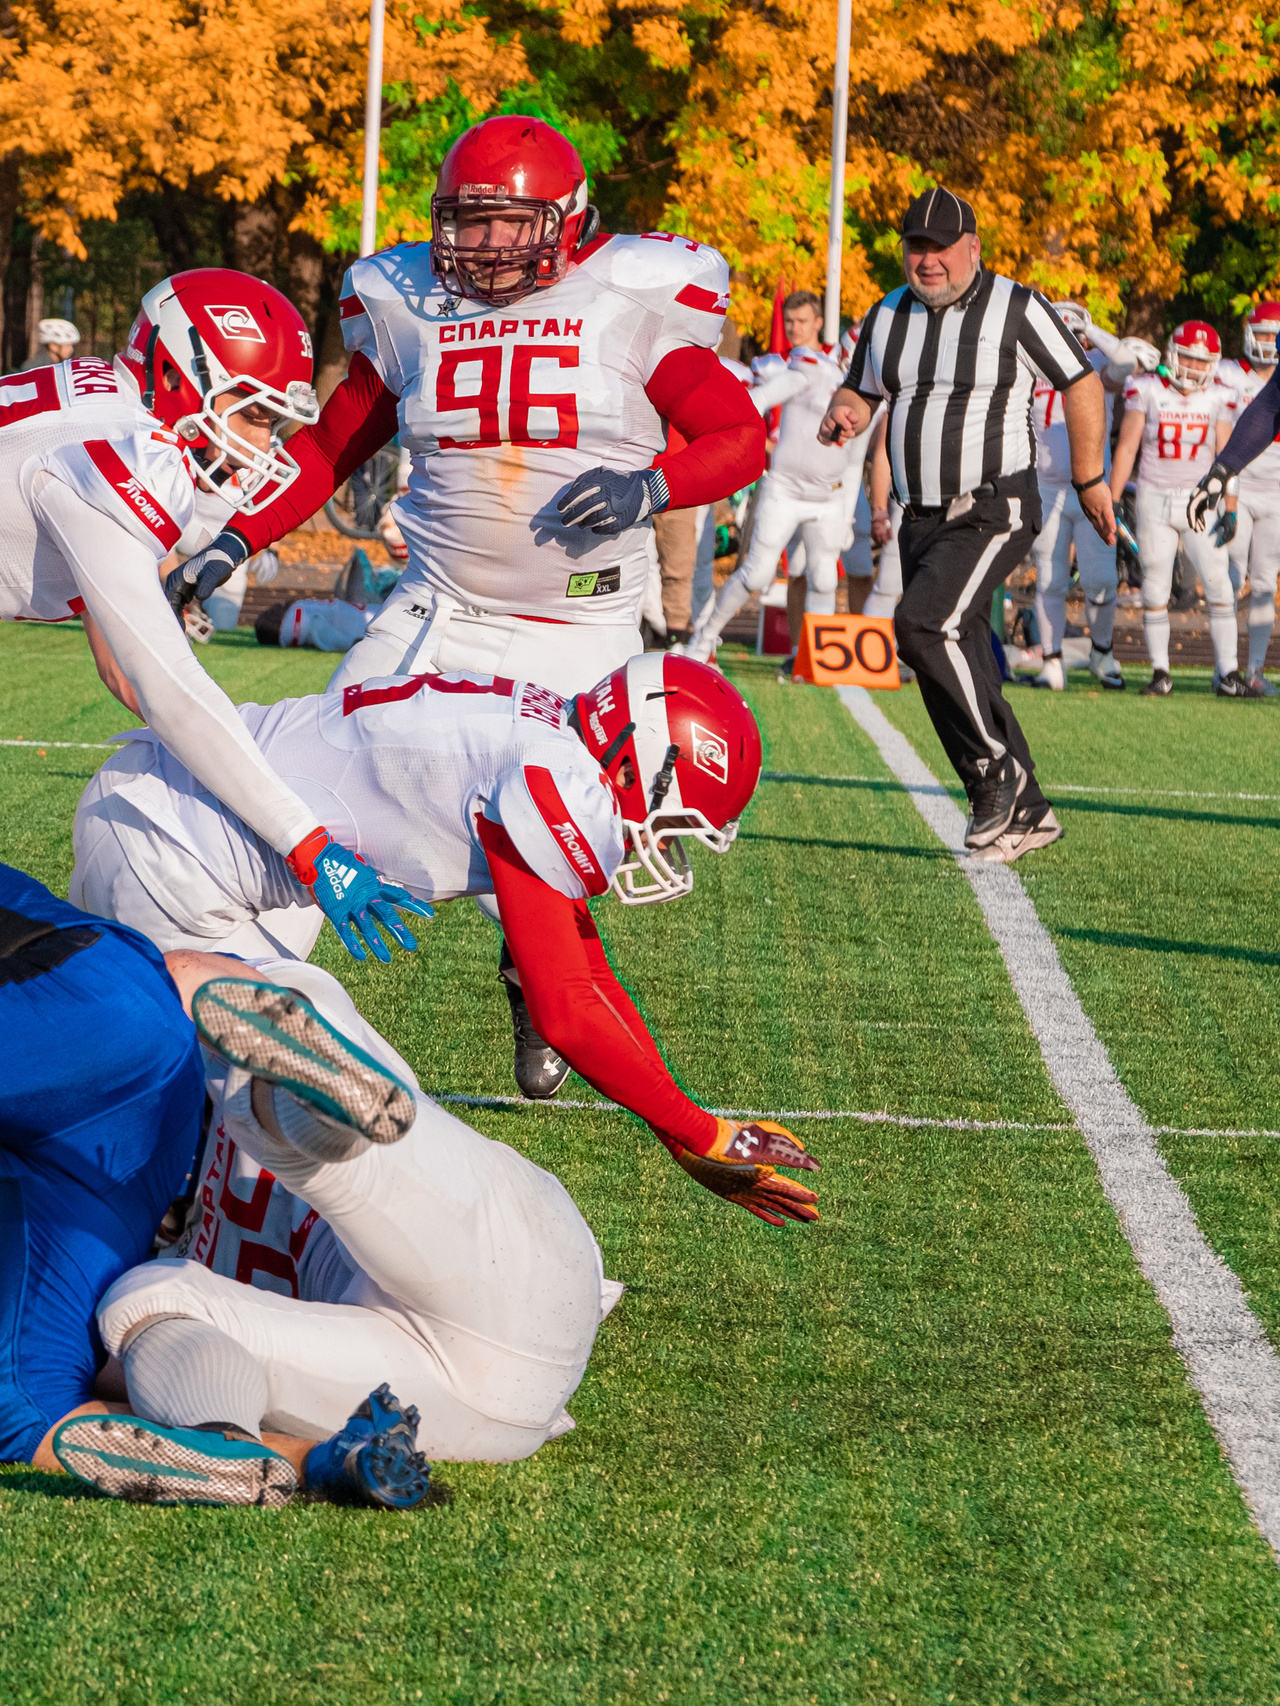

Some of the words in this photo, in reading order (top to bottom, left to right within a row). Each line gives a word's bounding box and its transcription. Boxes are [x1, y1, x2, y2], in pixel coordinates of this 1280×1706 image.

[438, 318, 584, 344] СПАРТАК
[436, 344, 581, 450] 96
[1034, 388, 1067, 430] 7
[1158, 422, 1210, 461] 87
[814, 626, 893, 673] 50
[322, 857, 346, 901] adidas
